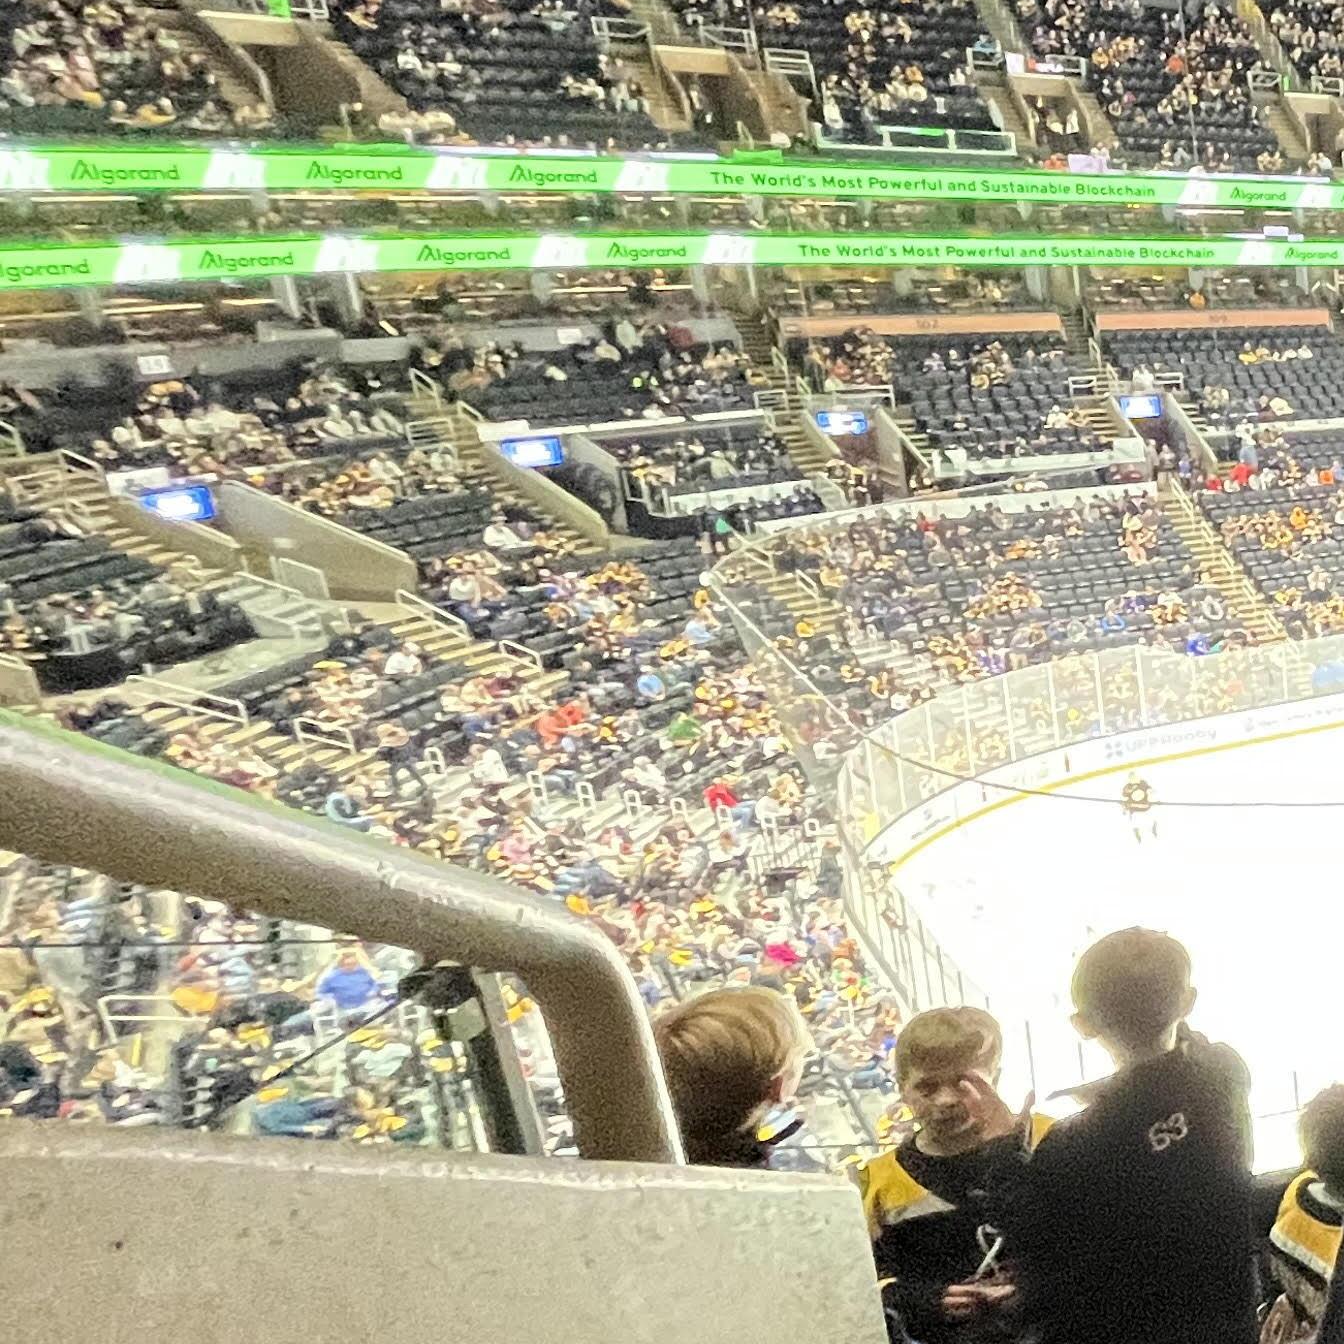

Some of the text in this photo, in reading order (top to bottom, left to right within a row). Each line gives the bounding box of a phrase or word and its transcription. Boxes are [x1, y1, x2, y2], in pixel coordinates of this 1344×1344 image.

[71, 160, 597, 186] Algorand Algorand Algorand
[710, 171, 1156, 197] The World's Most Powerful and Sustainable Blockchain
[1230, 186, 1287, 202] Algorand
[0, 242, 687, 282] lgorand Algorand Algorand Algorand
[797, 244, 1215, 260] The World's Most Powerful and Sustainable Blockchain
[1285, 247, 1338, 261] Algorand
[1149, 1112, 1188, 1151] 63
